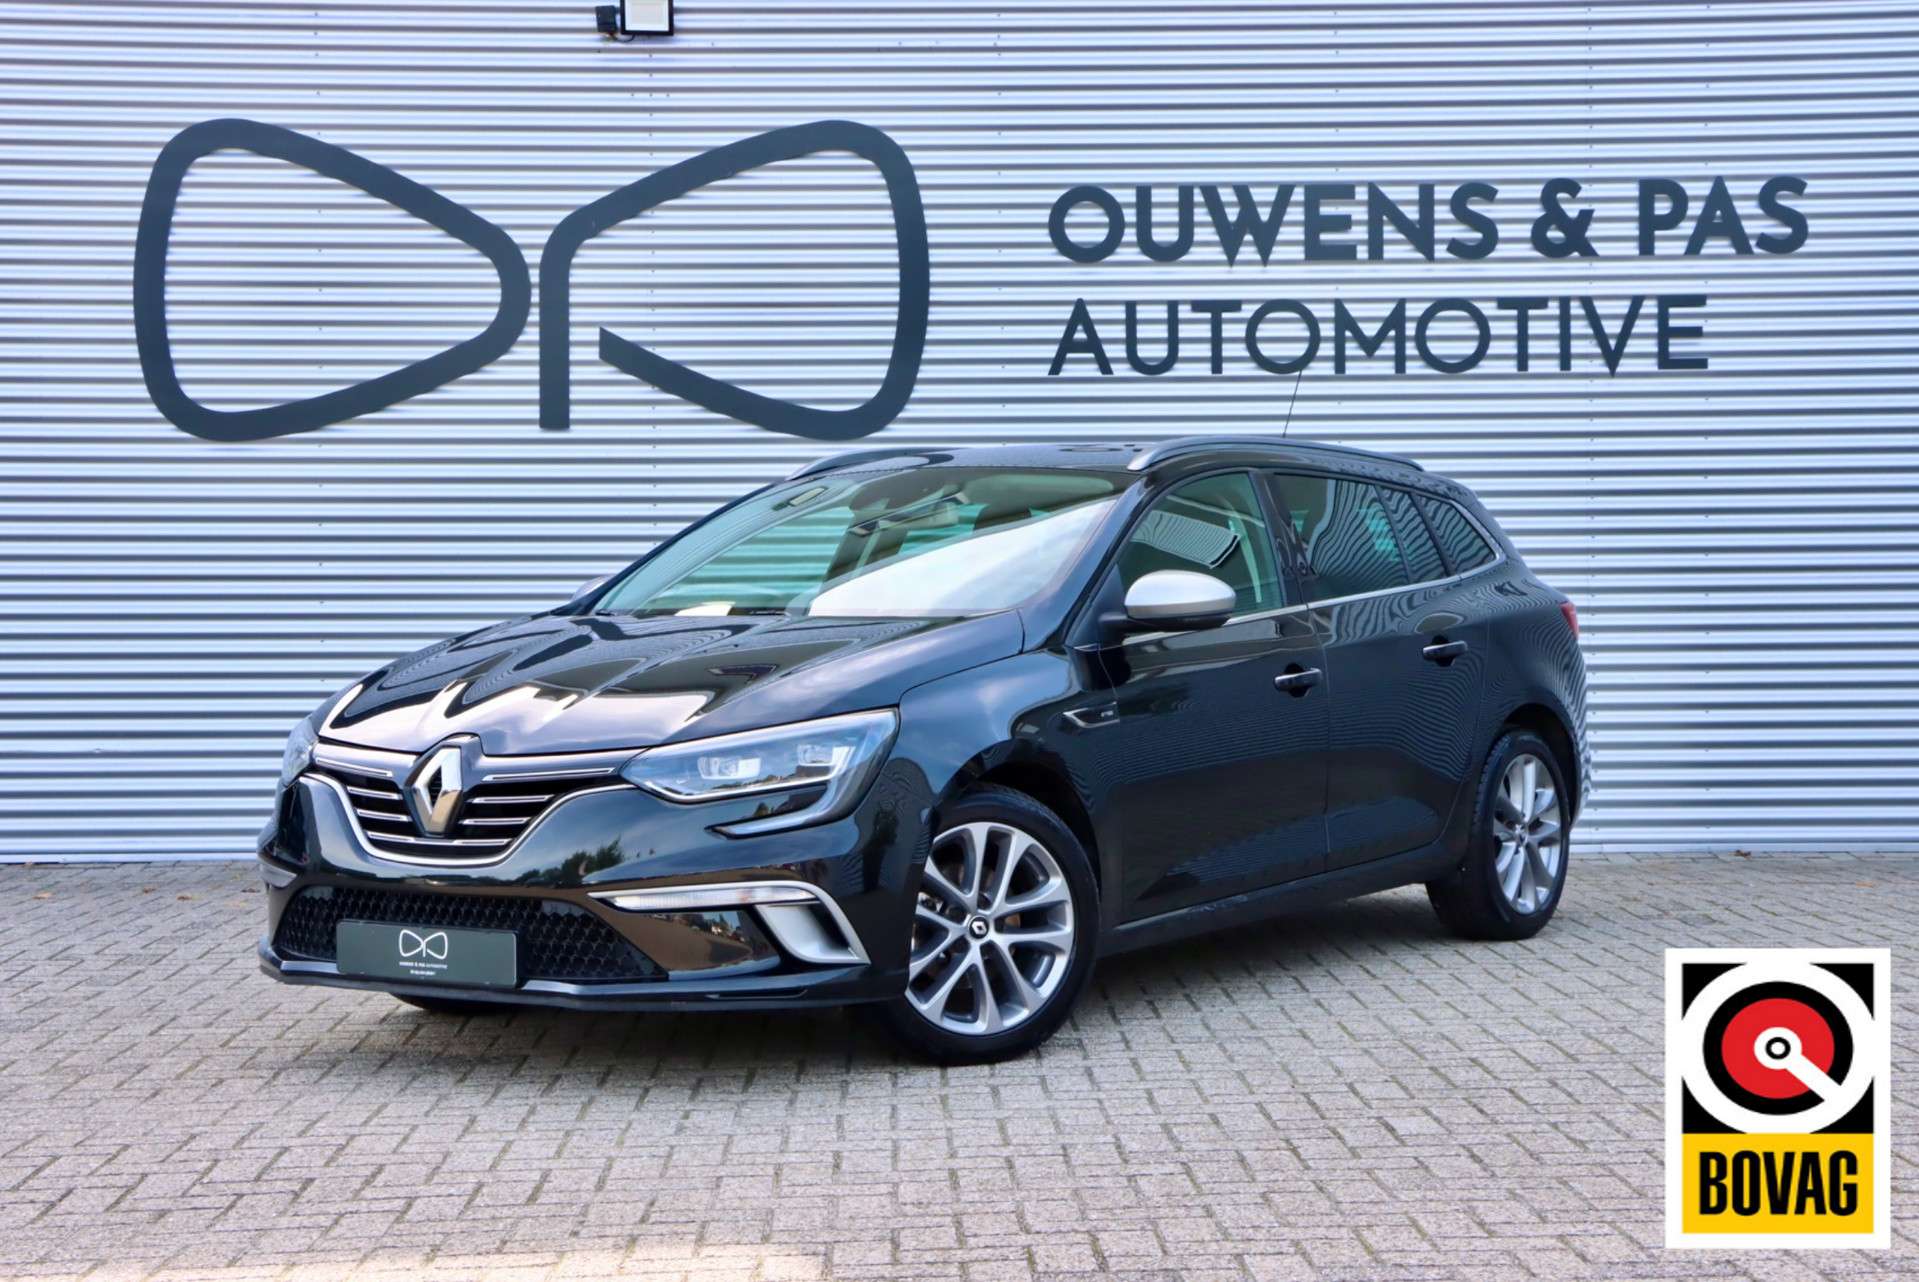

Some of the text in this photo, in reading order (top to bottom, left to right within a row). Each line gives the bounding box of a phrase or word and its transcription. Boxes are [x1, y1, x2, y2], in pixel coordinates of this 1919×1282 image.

[1048, 175, 1809, 267] OUWENS & PAS
[1048, 295, 1709, 378] AUTOMOTIVE
